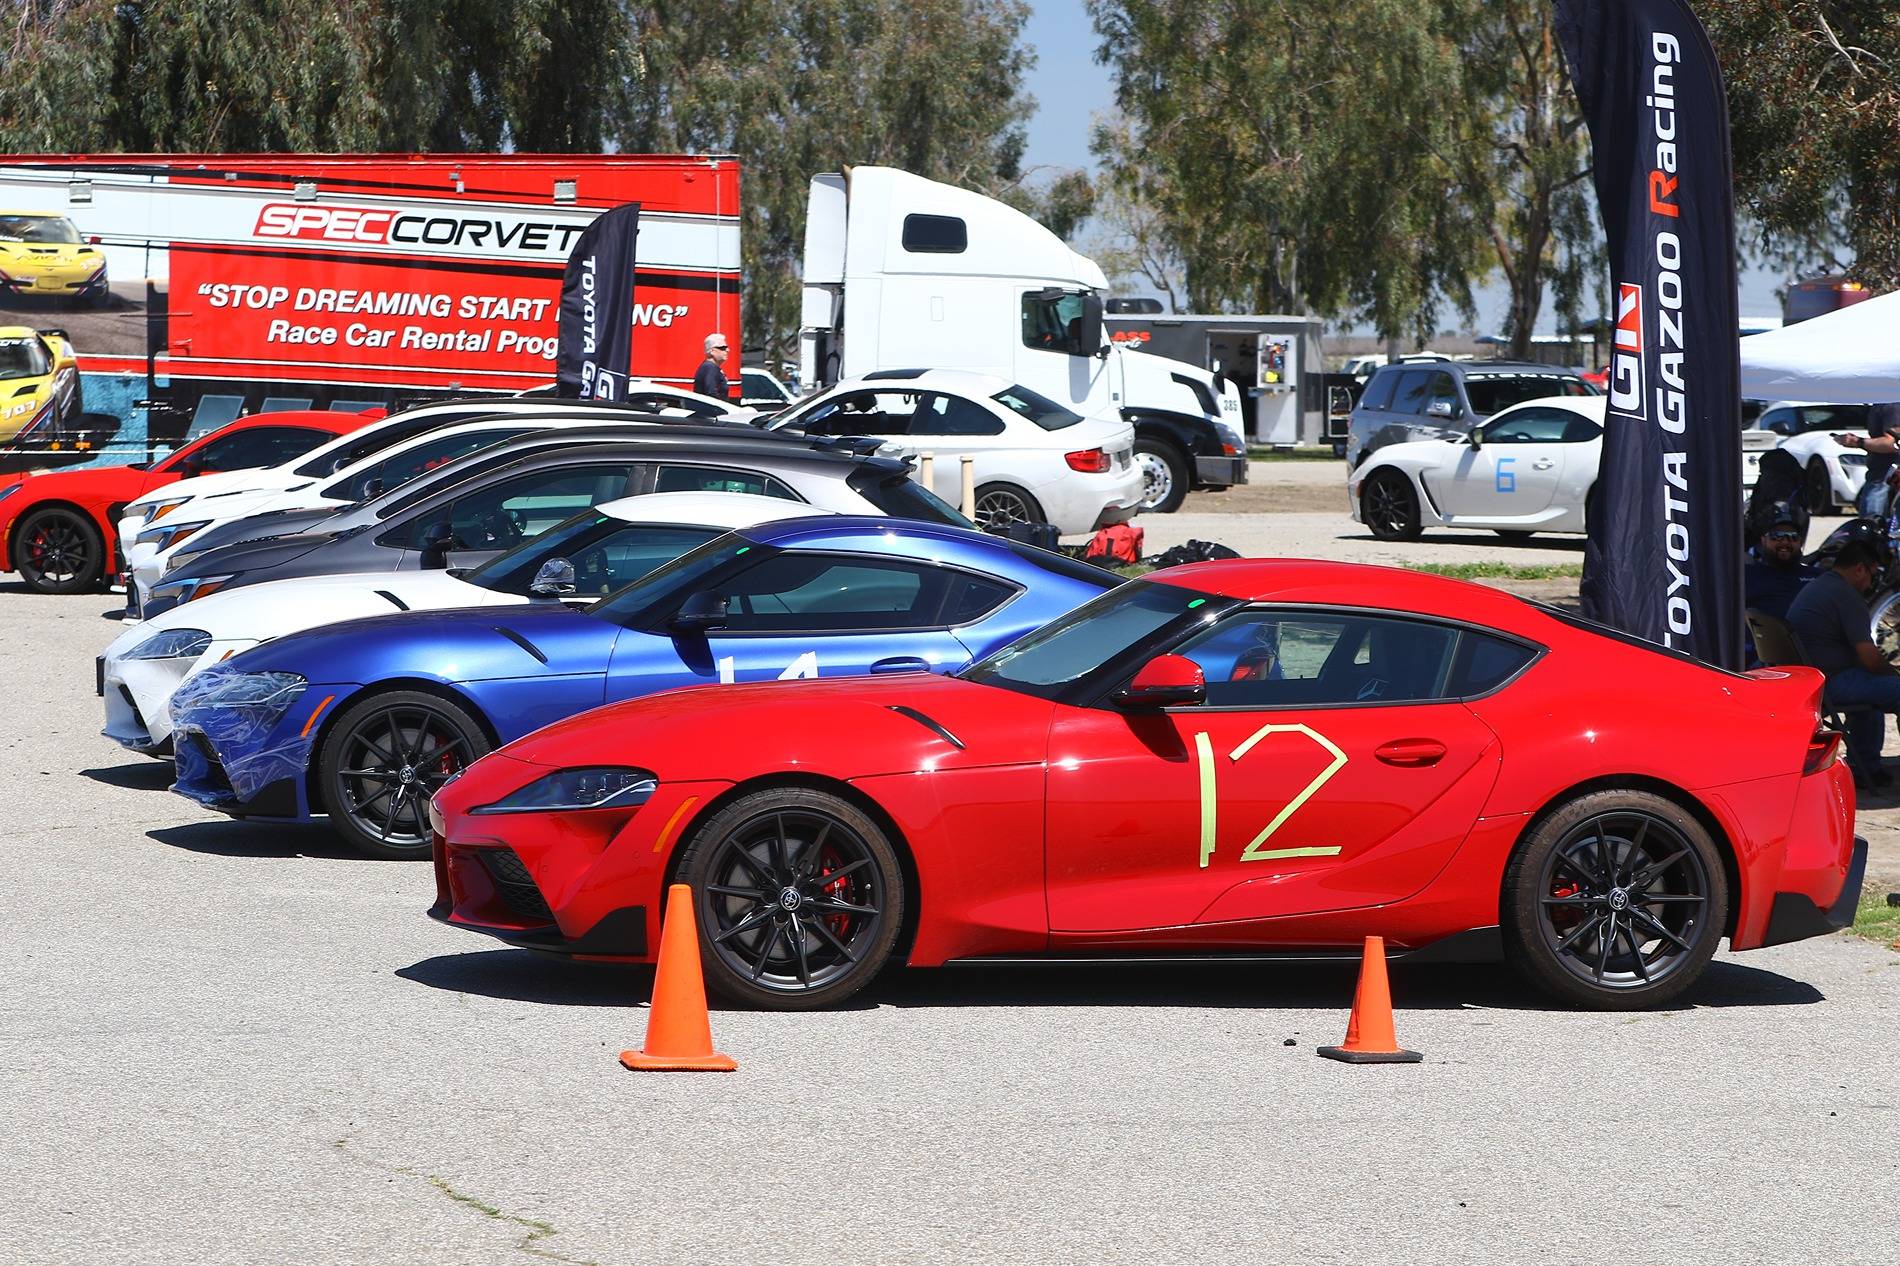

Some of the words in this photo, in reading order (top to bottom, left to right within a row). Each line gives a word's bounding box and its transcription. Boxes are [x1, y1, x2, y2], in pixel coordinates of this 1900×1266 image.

[1646, 31, 1681, 218] Racing
[257, 206, 391, 241] SPEC
[391, 216, 589, 251] CORVET
[267, 319, 338, 345] Race
[345, 323, 396, 348] Car
[400, 325, 492, 352] Rental
[496, 329, 560, 360] Prog
[294, 287, 452, 317] DREAMING
[458, 293, 551, 322] START
[582, 255, 597, 354] TOYOTA
[1610, 289, 1641, 412] GR
[1655, 231, 1686, 434] GAZOO
[1495, 457, 1516, 493] 6
[1194, 722, 1349, 869] 12
